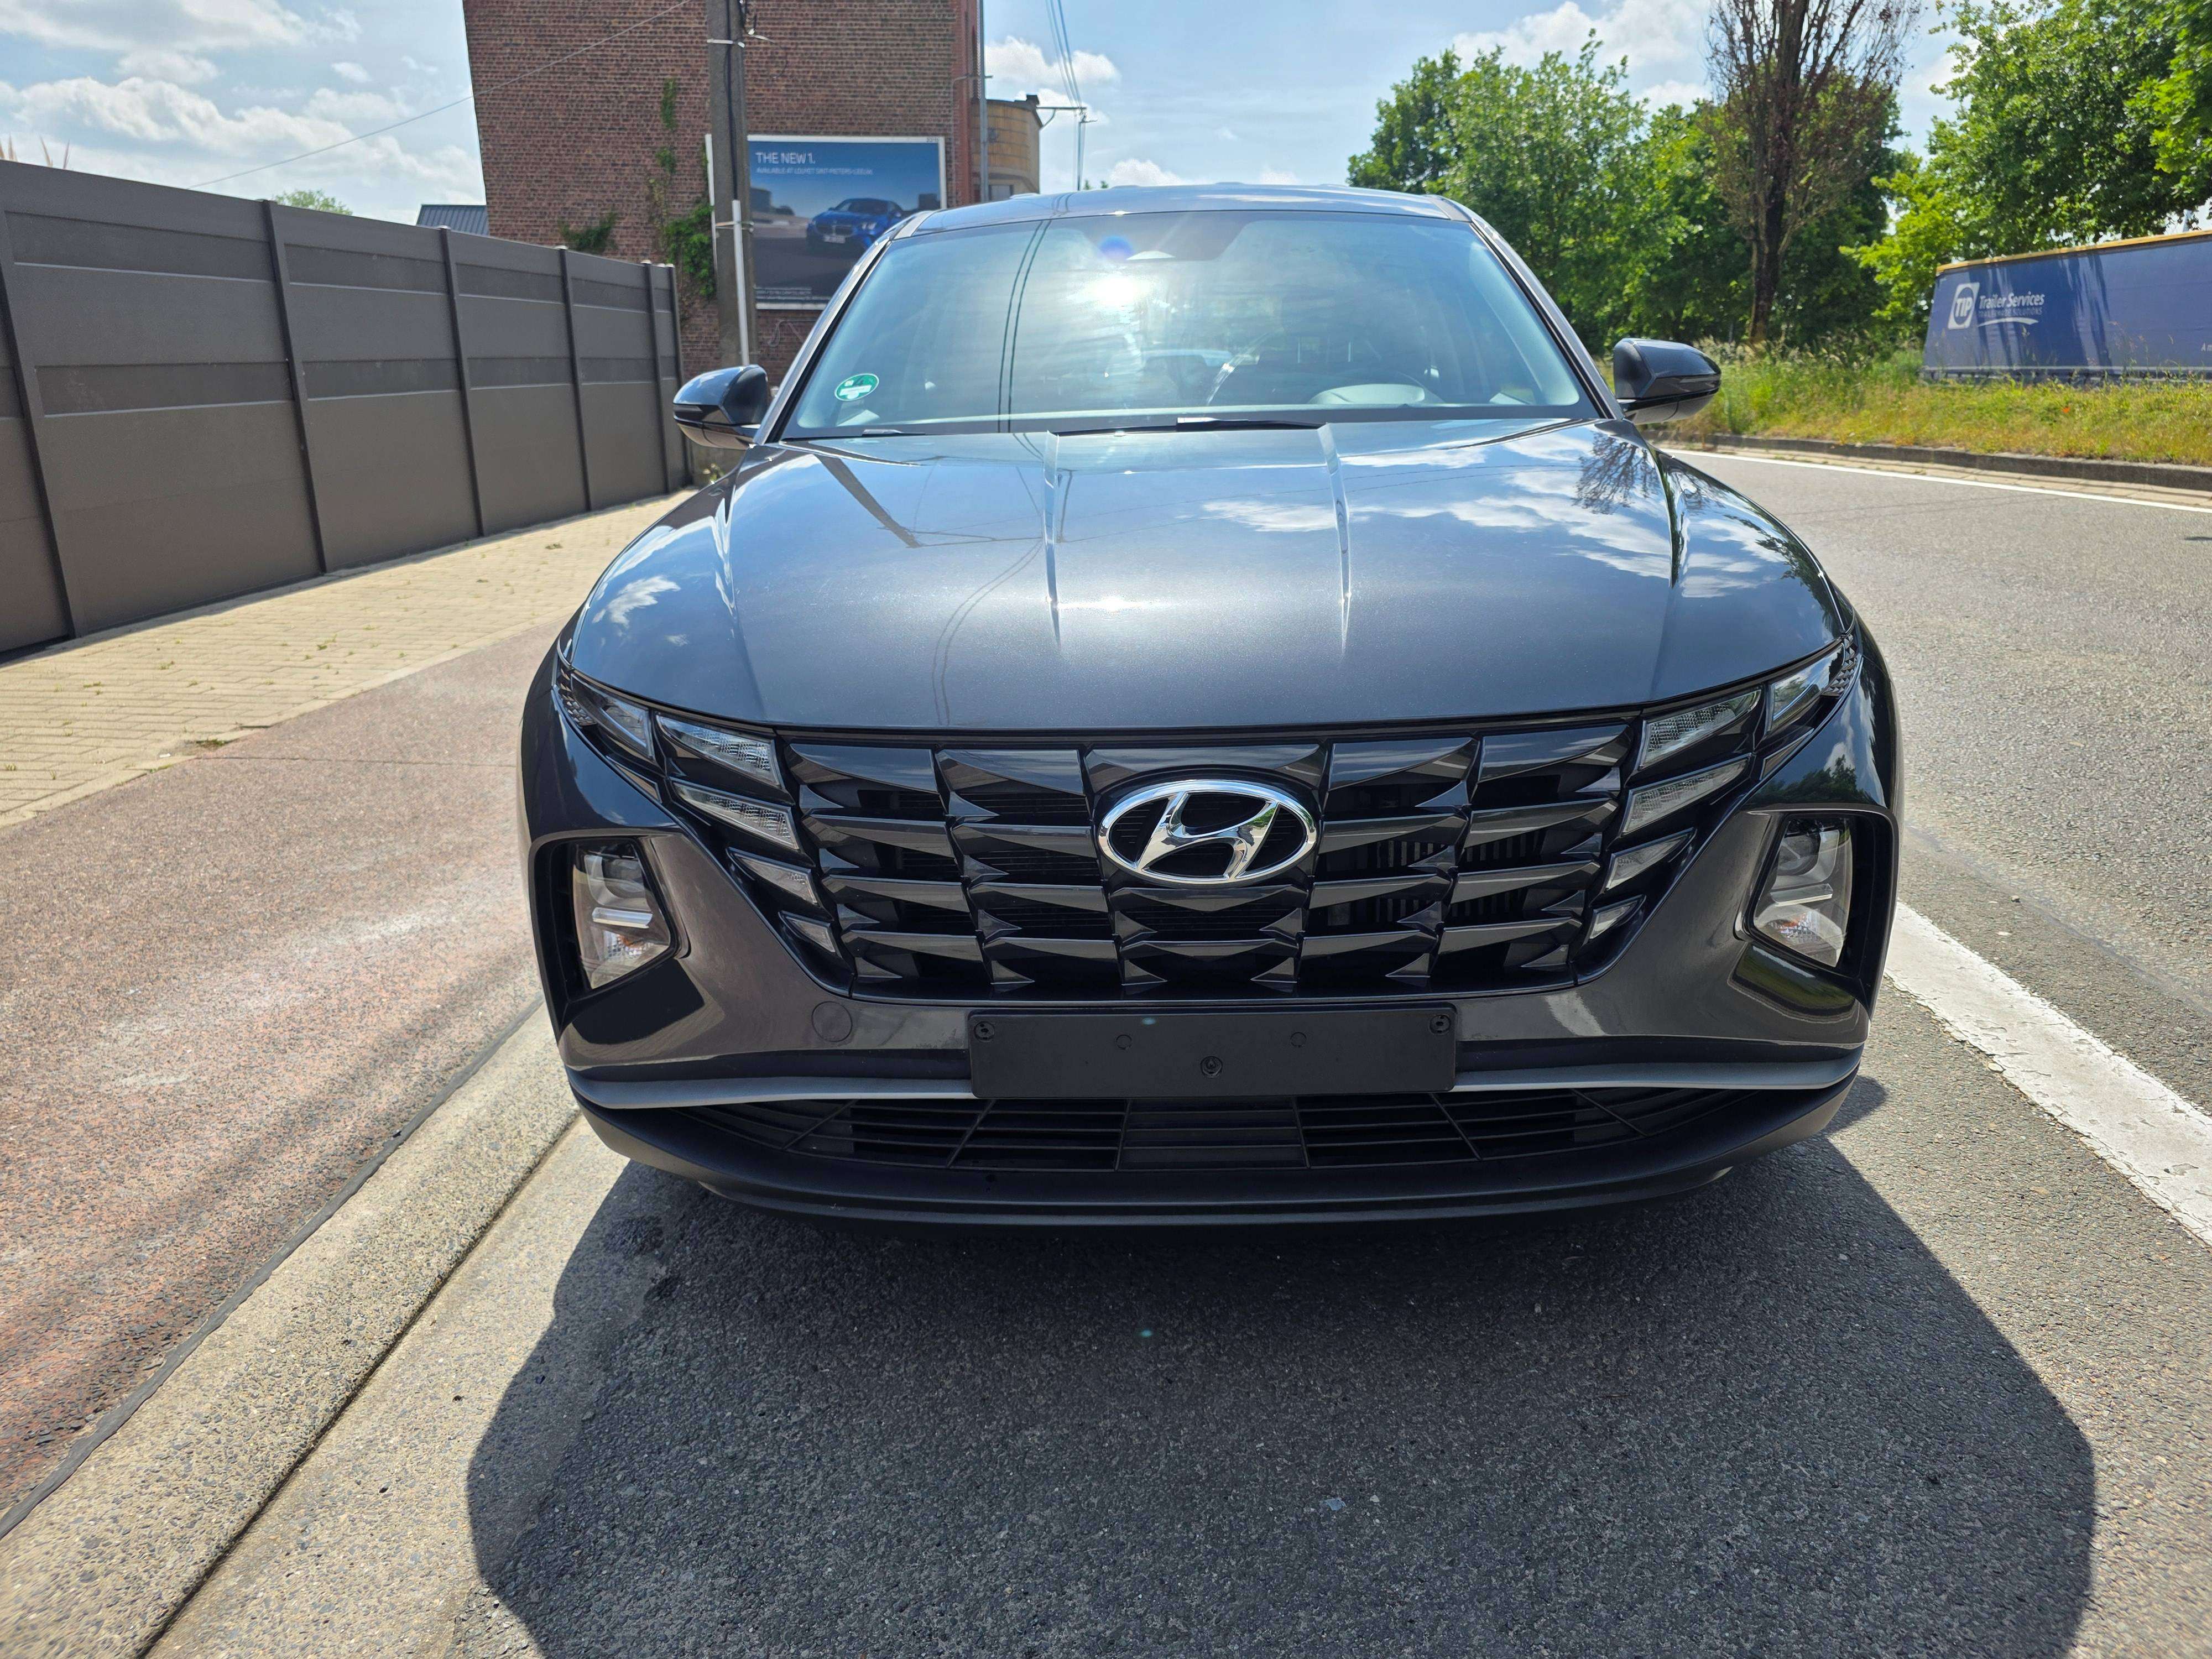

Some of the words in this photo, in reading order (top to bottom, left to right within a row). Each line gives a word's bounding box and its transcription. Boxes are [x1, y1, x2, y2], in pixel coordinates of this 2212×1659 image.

[755, 152, 779, 164] THE
[780, 152, 806, 164] NEW
[1955, 296, 1974, 317] TIP
[1979, 294, 2007, 310] Trailer
[2006, 291, 2045, 307] Services
